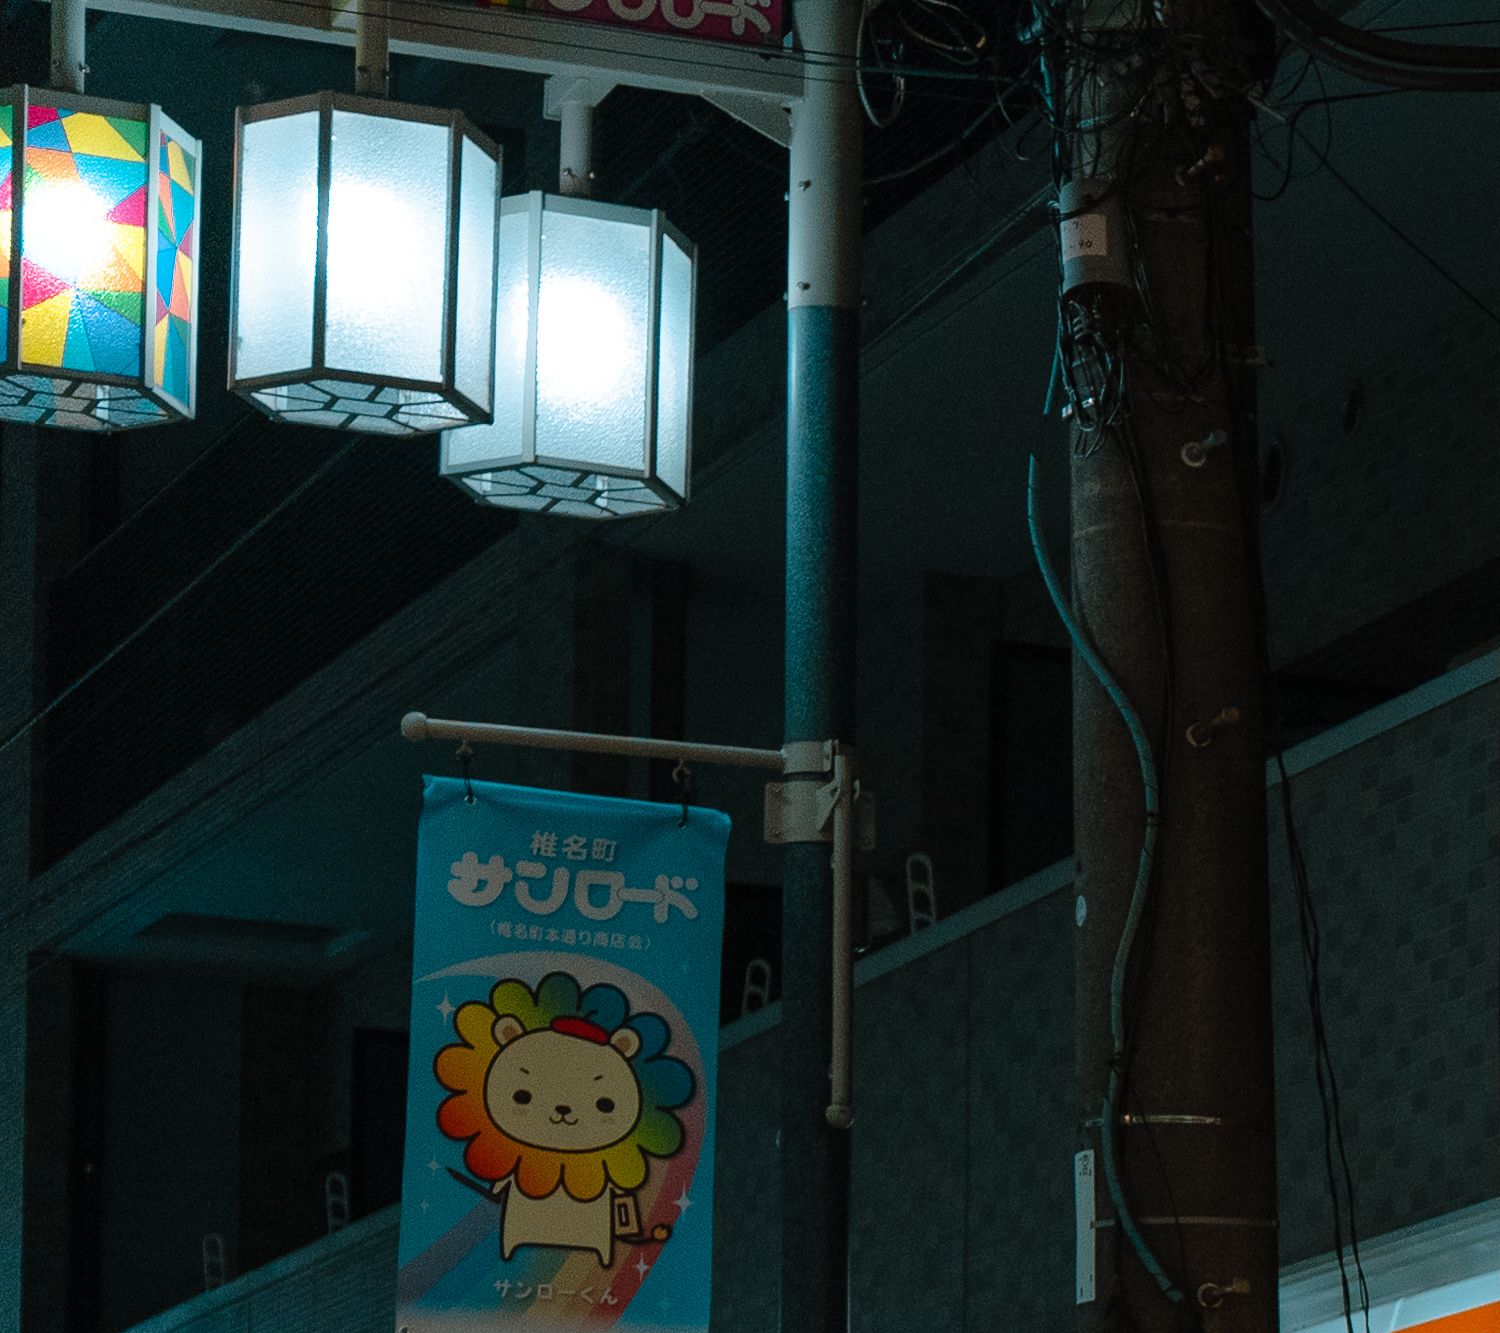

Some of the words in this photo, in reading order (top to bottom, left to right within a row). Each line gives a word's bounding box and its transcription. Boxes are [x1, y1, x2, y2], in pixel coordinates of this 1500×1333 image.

[530, 829, 618, 864] 椎名町
[447, 850, 699, 923] サンロード
